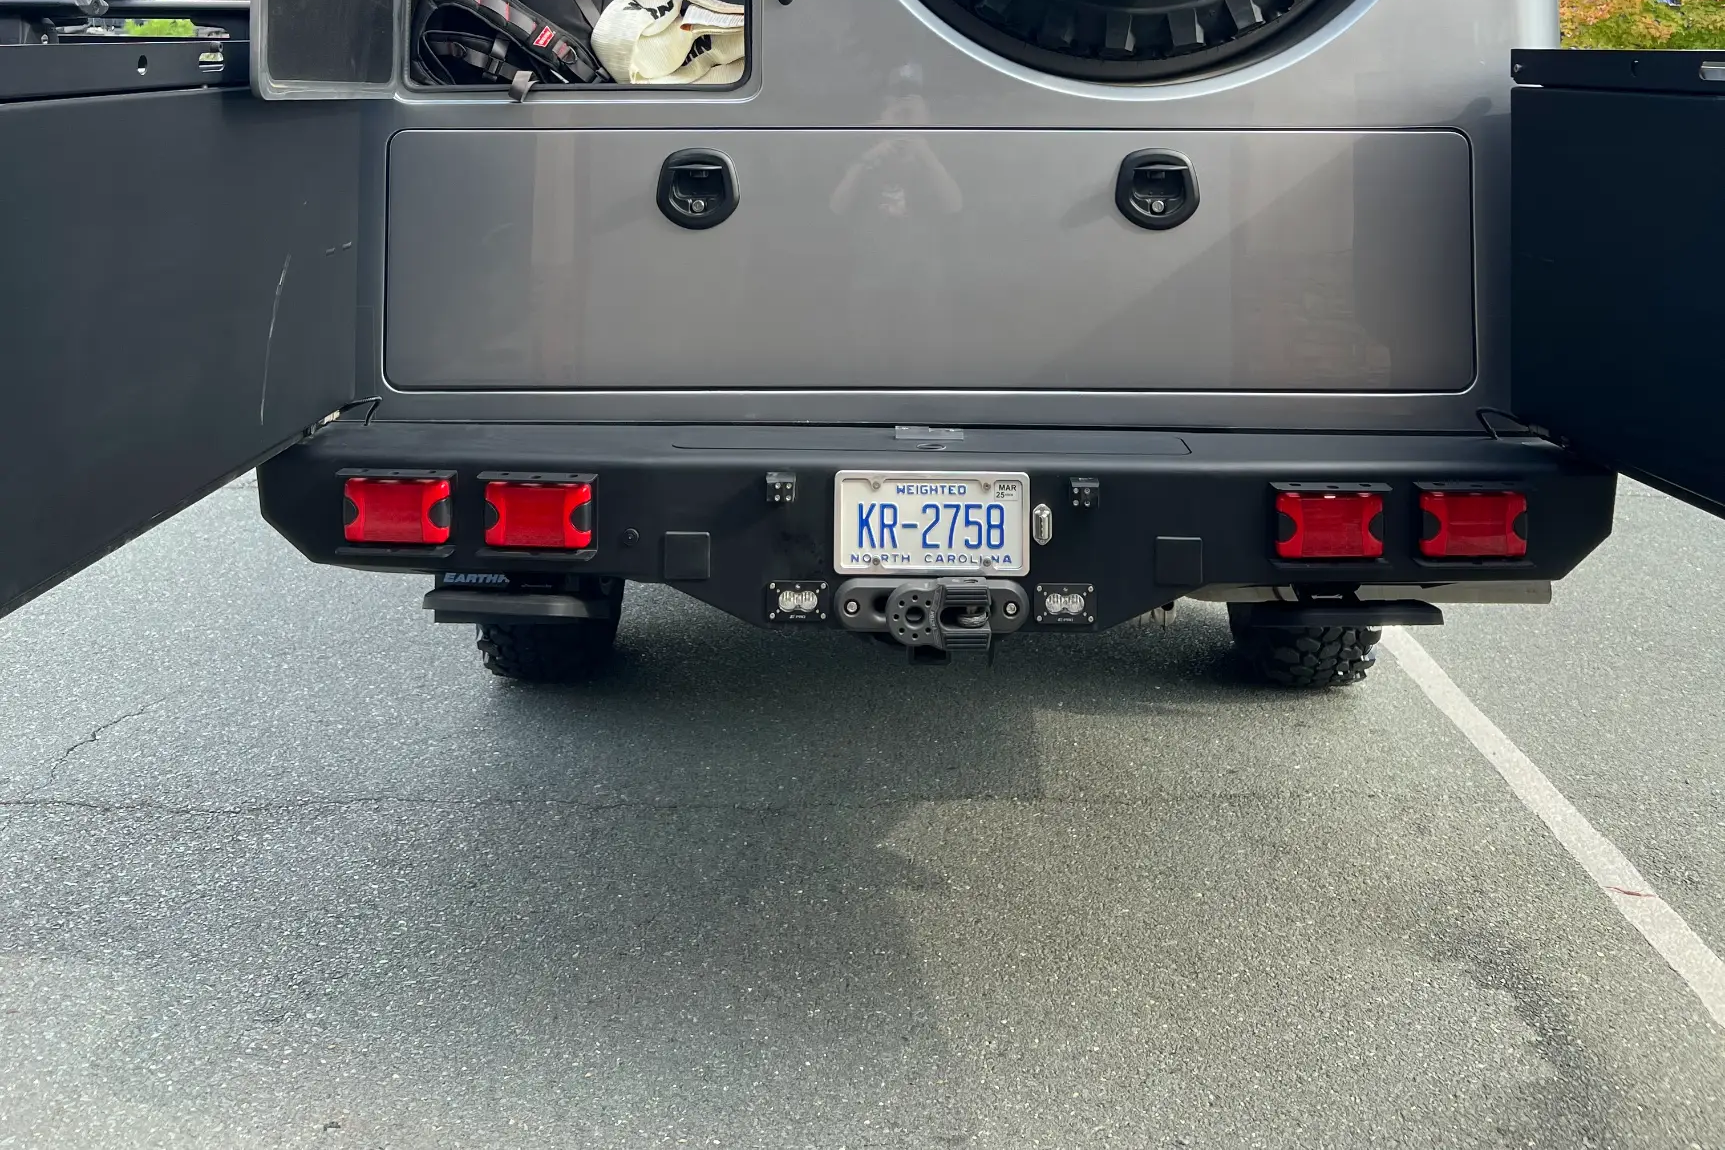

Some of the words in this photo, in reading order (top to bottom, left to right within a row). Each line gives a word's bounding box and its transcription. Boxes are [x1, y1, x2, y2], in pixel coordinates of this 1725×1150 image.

[896, 483, 967, 496] WEIGHTED
[995, 491, 1005, 499] 25
[857, 502, 1005, 550] KR-2758
[850, 553, 911, 564] NORTH
[924, 553, 1012, 564] CAROLINA
